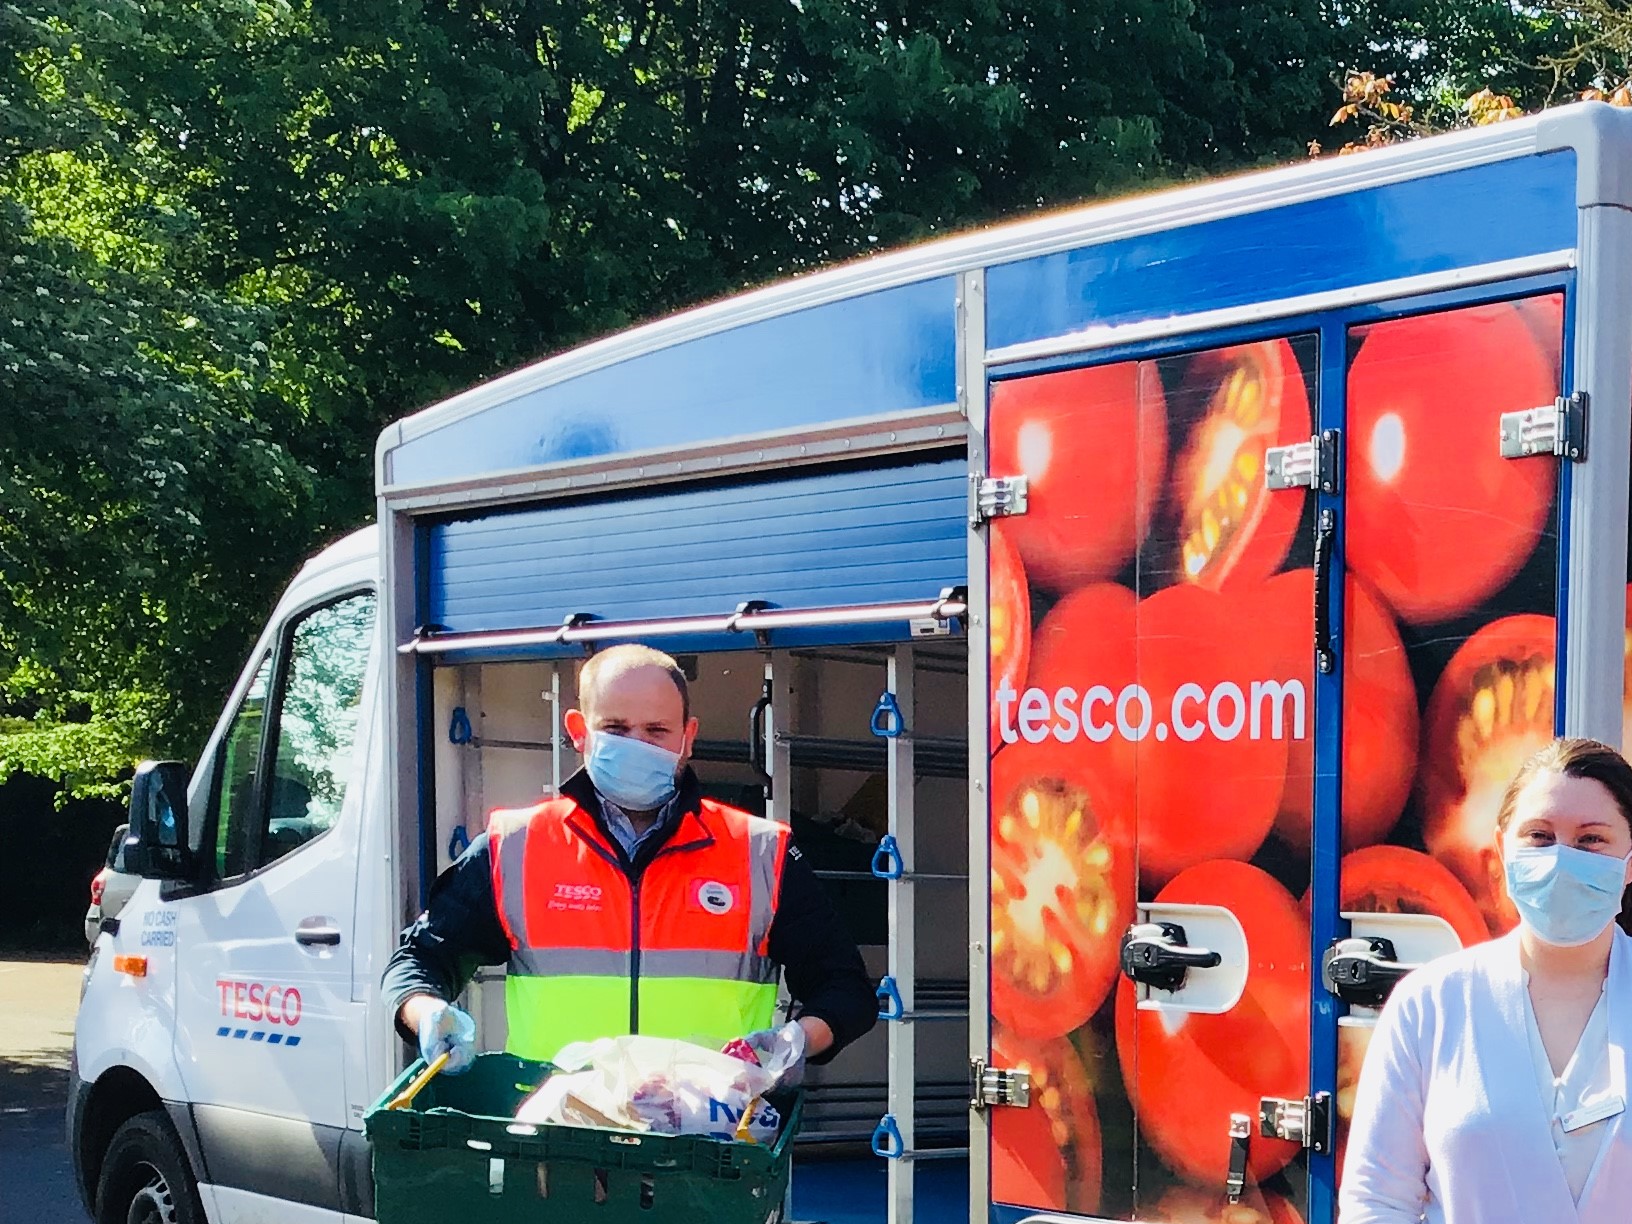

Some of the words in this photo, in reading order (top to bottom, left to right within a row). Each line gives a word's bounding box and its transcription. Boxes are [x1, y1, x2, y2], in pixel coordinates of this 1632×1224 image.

[995, 678, 1306, 744] tesco.com
[554, 884, 602, 897] TESCO
[141, 931, 174, 947] CARRIED
[216, 980, 302, 1026] TESCO
